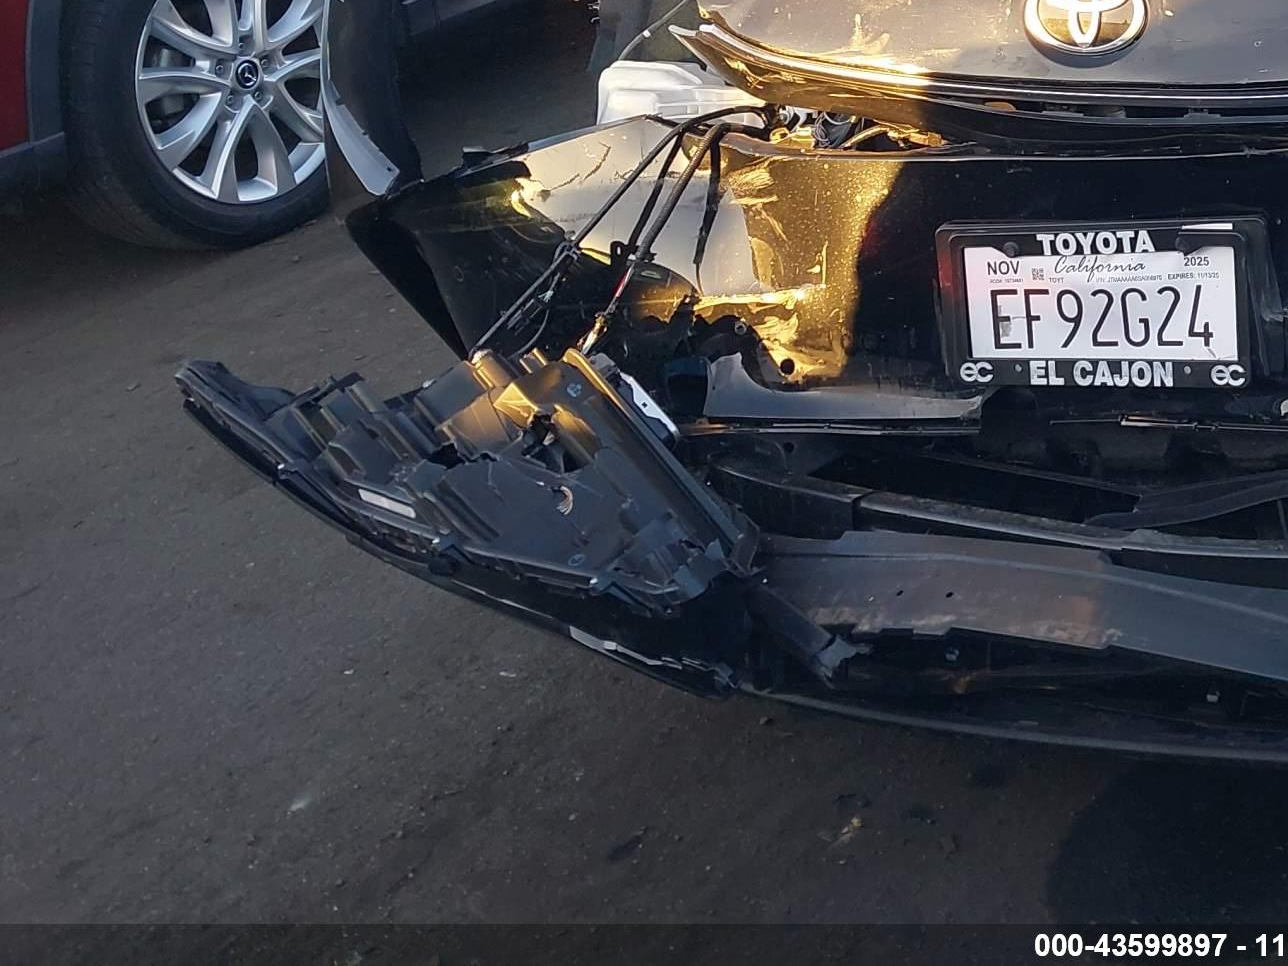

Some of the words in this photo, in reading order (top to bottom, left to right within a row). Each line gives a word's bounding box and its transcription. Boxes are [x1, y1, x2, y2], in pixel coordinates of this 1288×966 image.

[1036, 230, 1155, 256] TOYOTA
[987, 260, 1020, 276] NOV
[1054, 256, 1145, 283] California
[1183, 255, 1210, 267] 2025
[990, 284, 1214, 350] EF92G24
[1029, 361, 1064, 387] EL
[1073, 361, 1174, 387] CAJON
